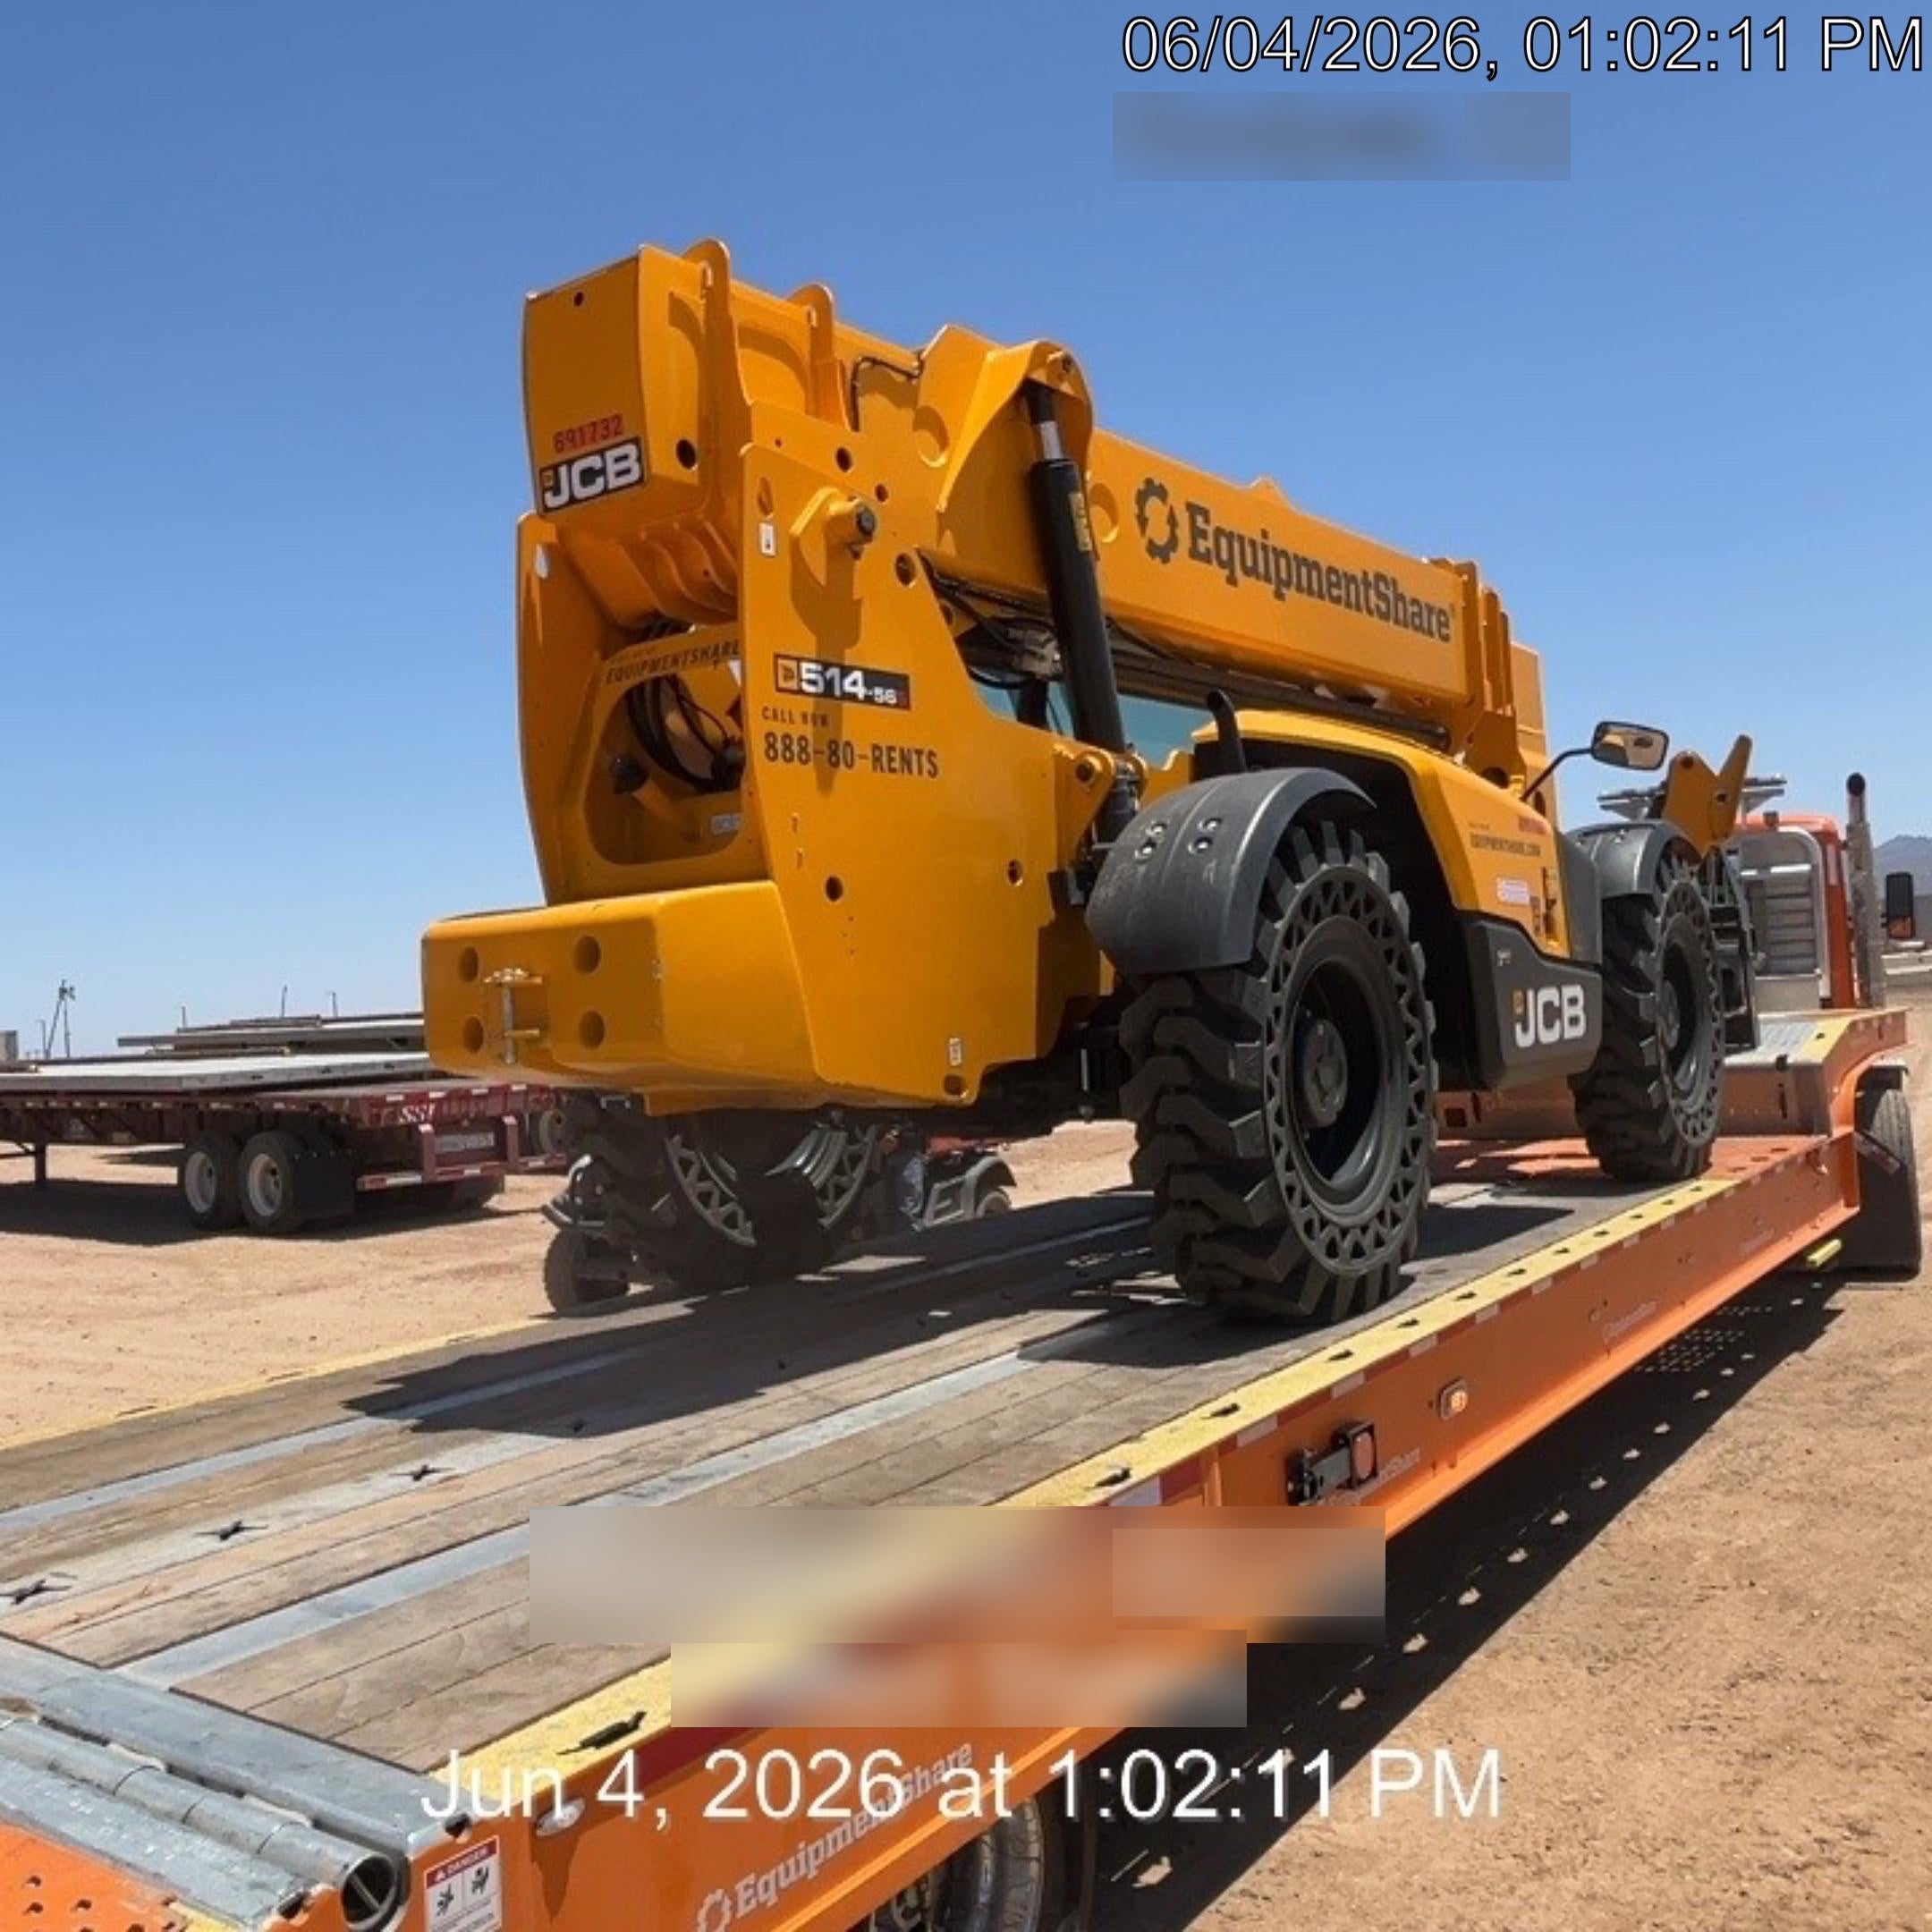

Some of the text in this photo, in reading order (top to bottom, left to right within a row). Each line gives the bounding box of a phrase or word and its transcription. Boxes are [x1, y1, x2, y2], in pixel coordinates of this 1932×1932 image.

[542, 442, 641, 509] JCB
[1185, 500, 1452, 643] EquipmentShare
[761, 705, 795, 725] CALL
[764, 731, 940, 779] 888-80-RENTS
[1515, 984, 1588, 1047] JCB
